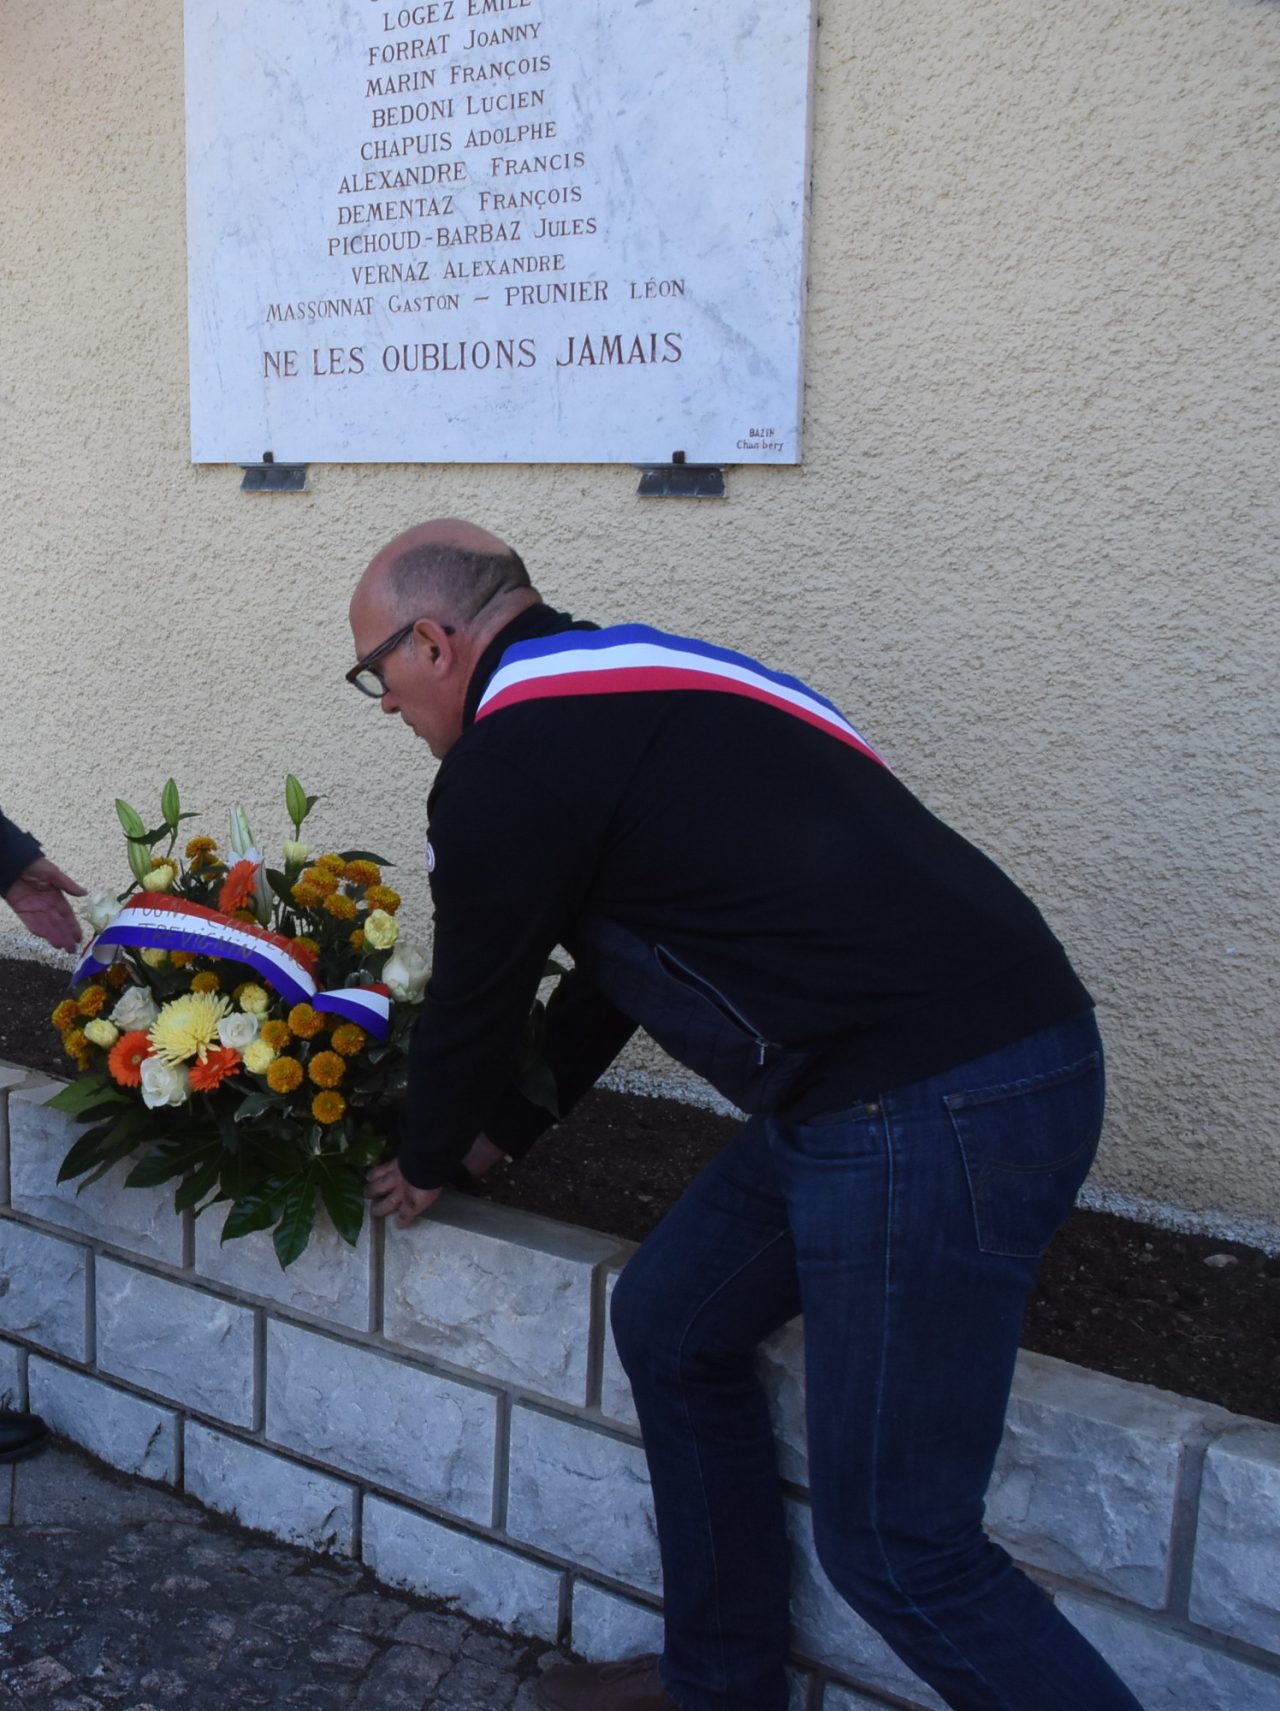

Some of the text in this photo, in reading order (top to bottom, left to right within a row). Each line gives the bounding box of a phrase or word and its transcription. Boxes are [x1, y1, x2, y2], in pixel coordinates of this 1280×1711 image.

[384, 0, 455, 31] LOGEZ
[368, 22, 542, 66] FORRAT JOANNY
[365, 55, 551, 97] MARIN FRANÇOIS
[371, 90, 545, 128] BEDONI LUCIEN
[360, 121, 557, 161] CHAPUIS ADOLPHE
[337, 151, 586, 194] ALEXANDRE FRANCIS
[337, 186, 583, 225] DEMENTAZ FRANÇOIS
[327, 217, 598, 256] PICHOUD-BARBAZ JULES
[352, 253, 566, 285] VERNAZ ALEXANDRE
[265, 296, 375, 323] MASSONNAT
[388, 293, 460, 314] GASTON
[504, 280, 609, 307] PRUNIER
[629, 277, 686, 300] LÉON
[263, 332, 684, 378] NE LES OUBLIONS JAMAIS
